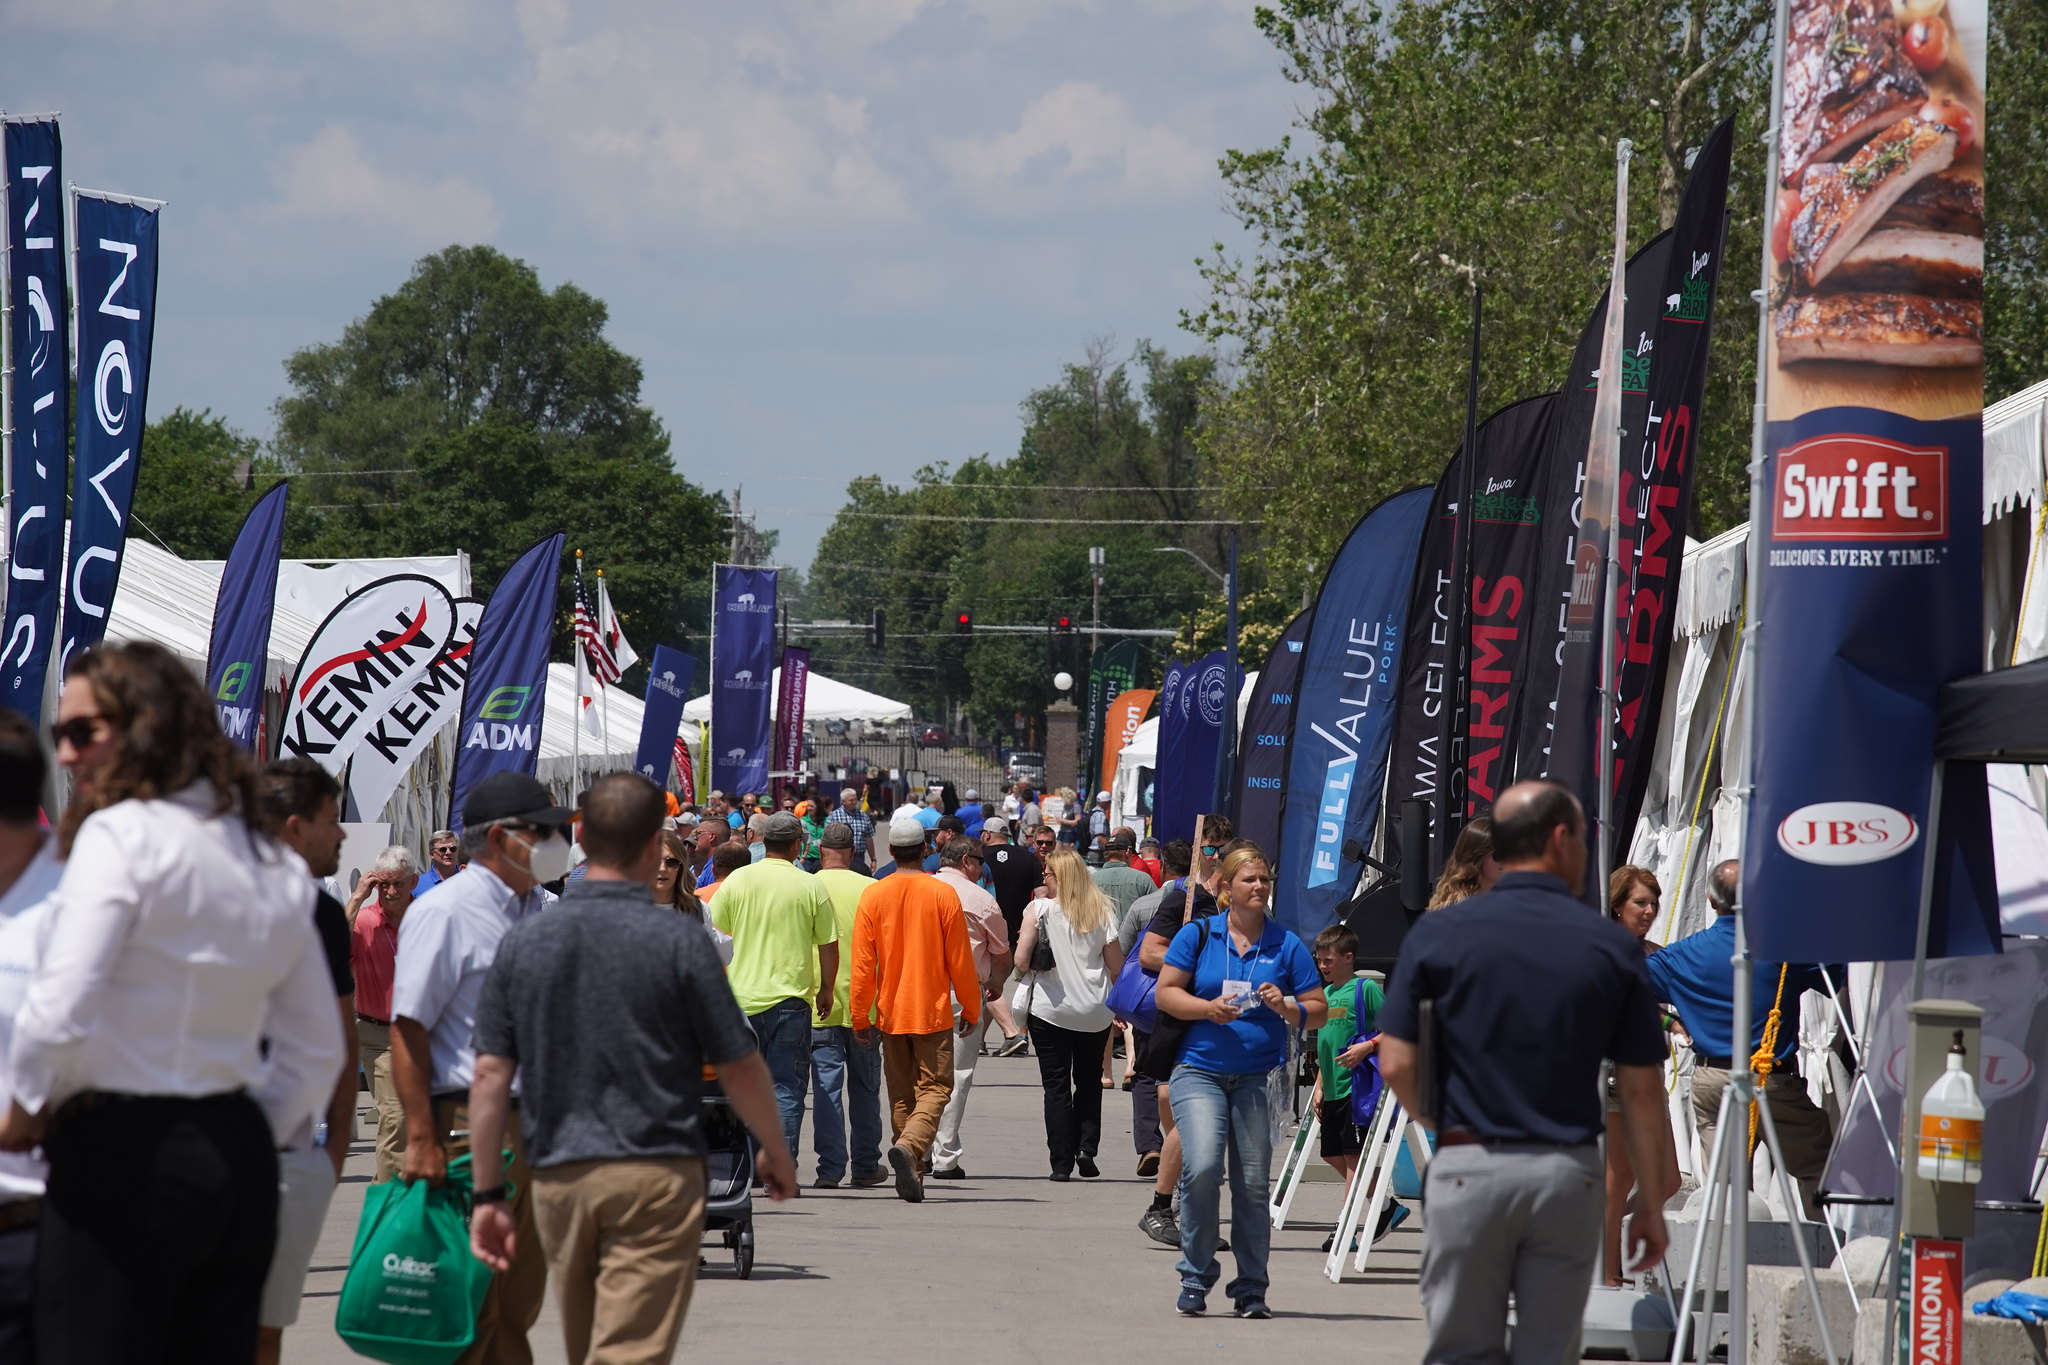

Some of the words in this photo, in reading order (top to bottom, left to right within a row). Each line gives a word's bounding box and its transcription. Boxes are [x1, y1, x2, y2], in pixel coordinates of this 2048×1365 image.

[1486, 477, 1517, 496] Iowa
[1783, 458, 1918, 518] Swift
[1830, 549, 1882, 567] EVERY
[283, 611, 436, 757] KEMIN
[465, 722, 533, 752] ADM
[1797, 818, 1889, 846] JBS
